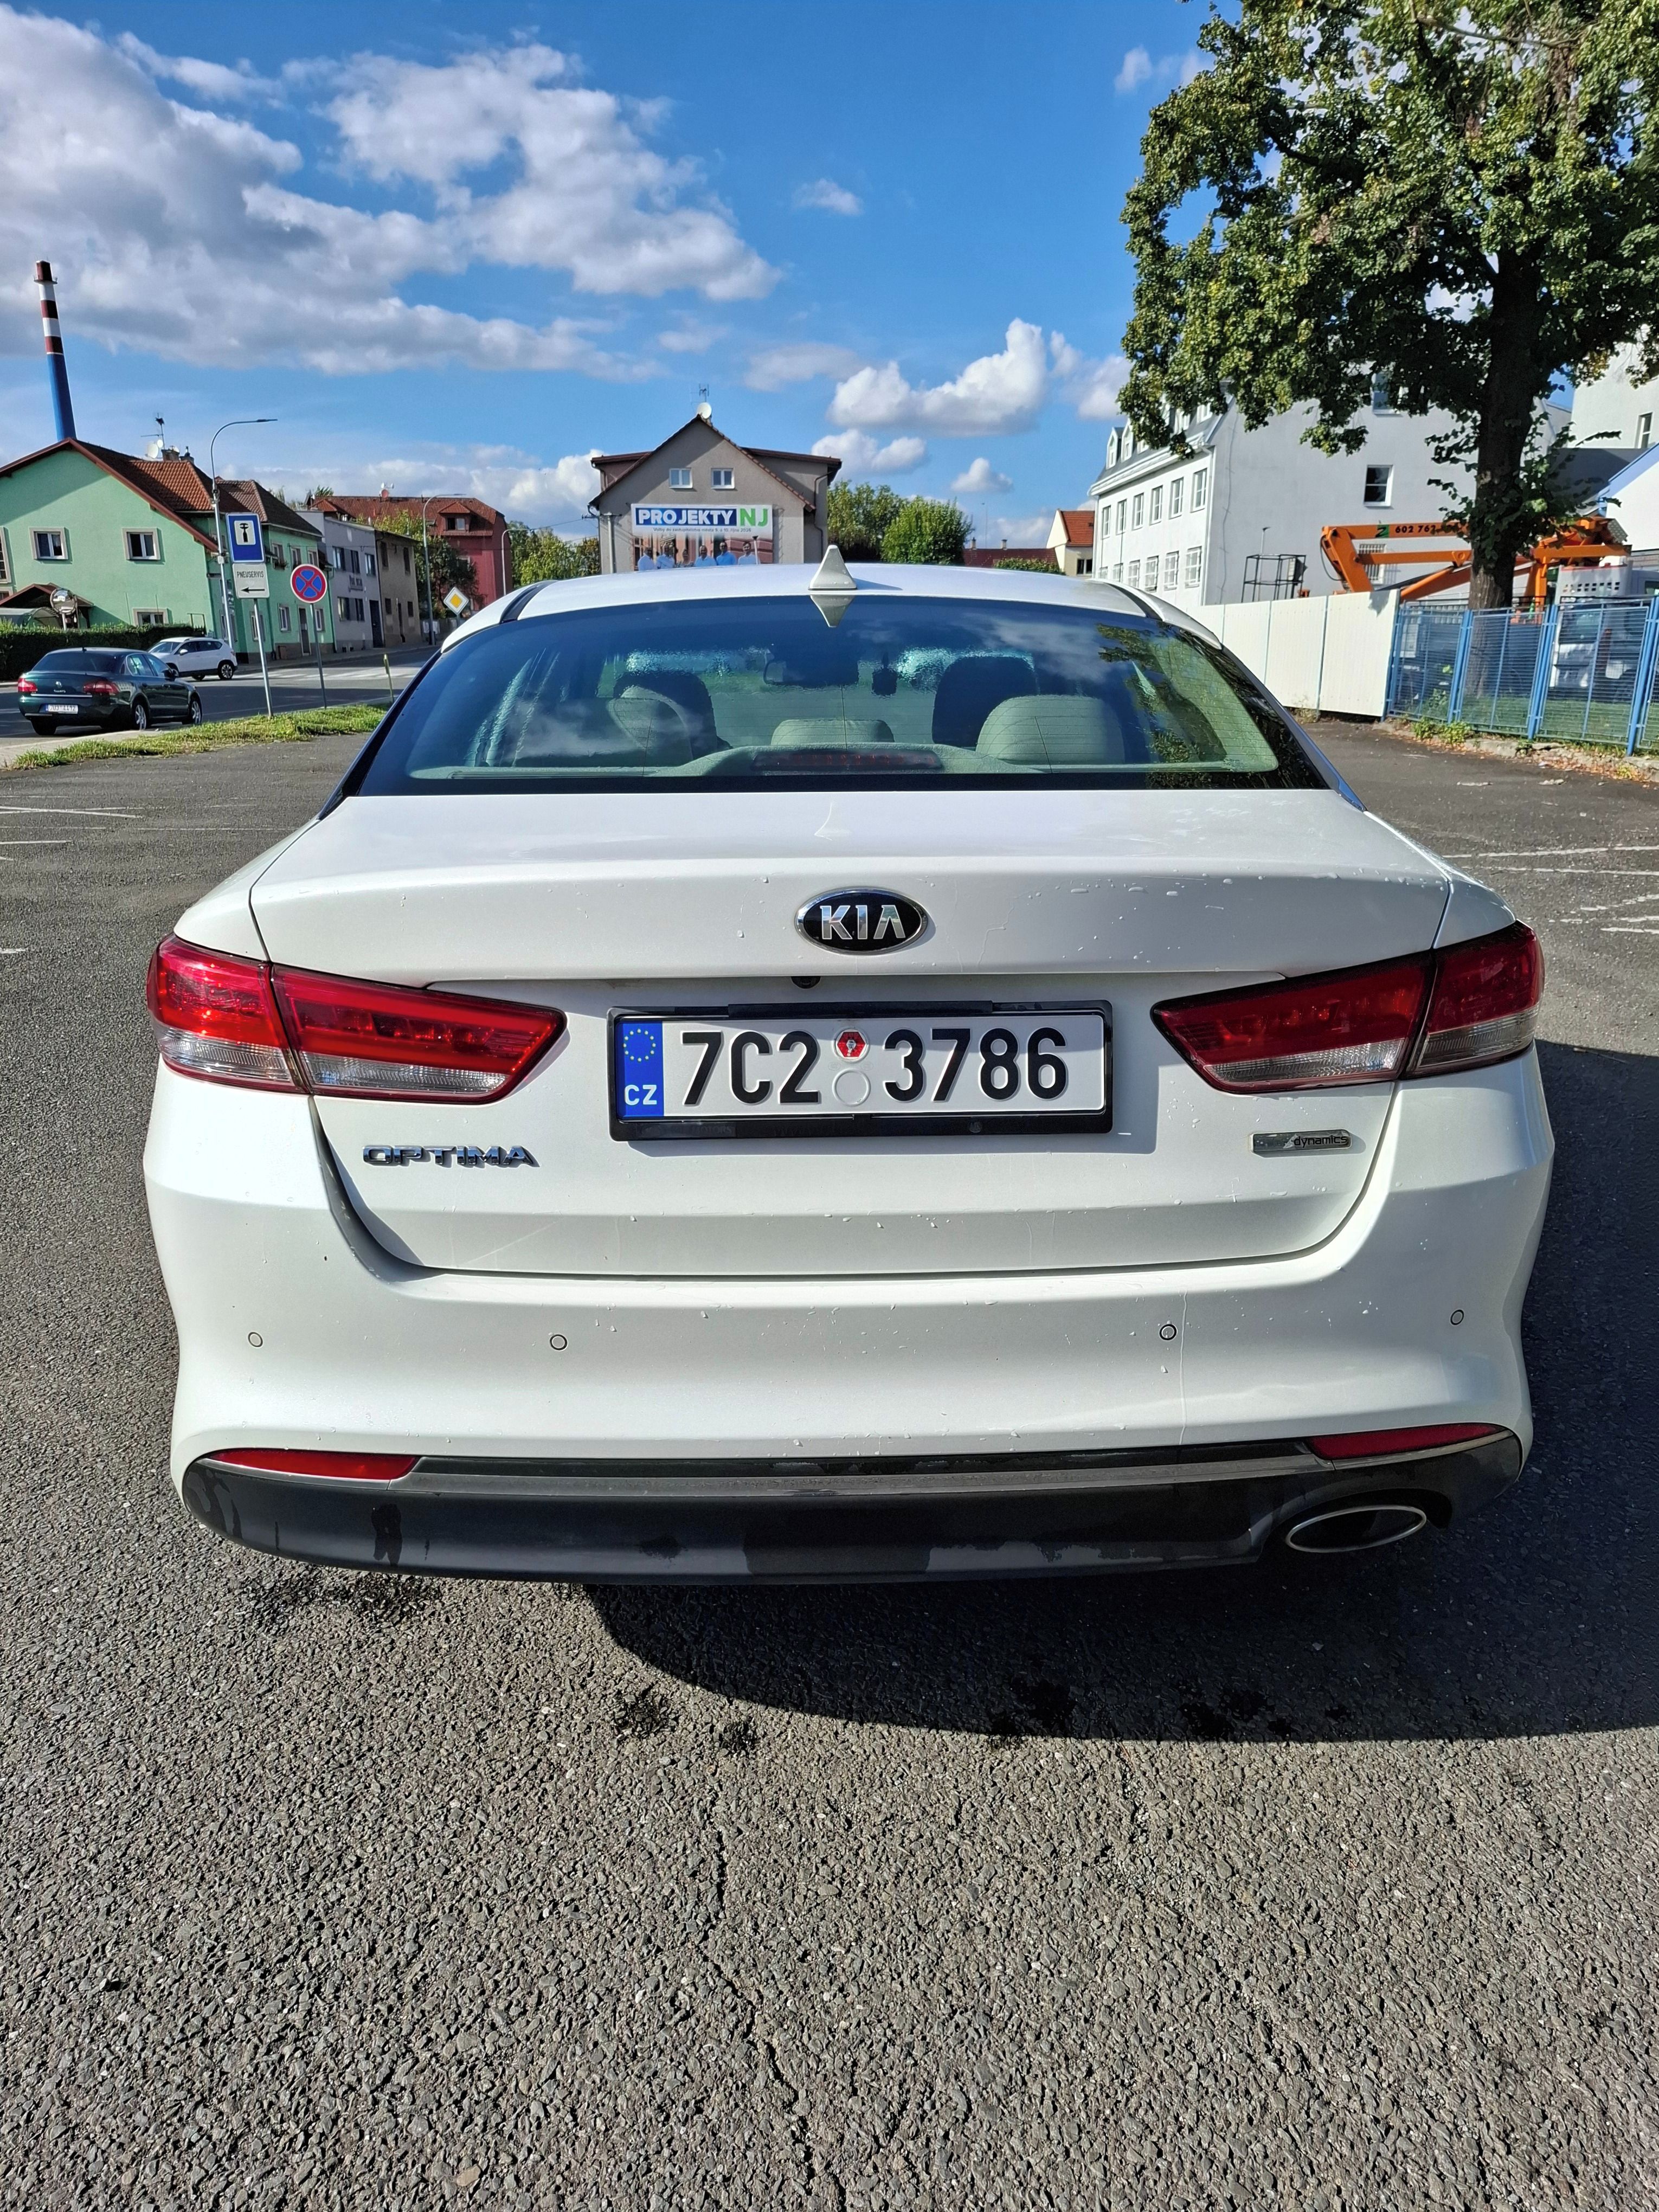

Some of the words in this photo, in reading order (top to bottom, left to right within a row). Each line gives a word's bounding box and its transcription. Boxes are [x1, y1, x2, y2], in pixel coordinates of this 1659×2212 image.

[638, 509, 734, 524] PROJEKTY
[740, 508, 769, 526] NJ
[1395, 525, 1413, 533] 602
[820, 904, 906, 940] KIA
[681, 1030, 821, 1106] 7C2
[883, 1027, 1068, 1103] 3786
[624, 1084, 657, 1105] CZ
[1294, 1135, 1348, 1148] dynamics
[363, 1145, 534, 1165] OPTIMA
